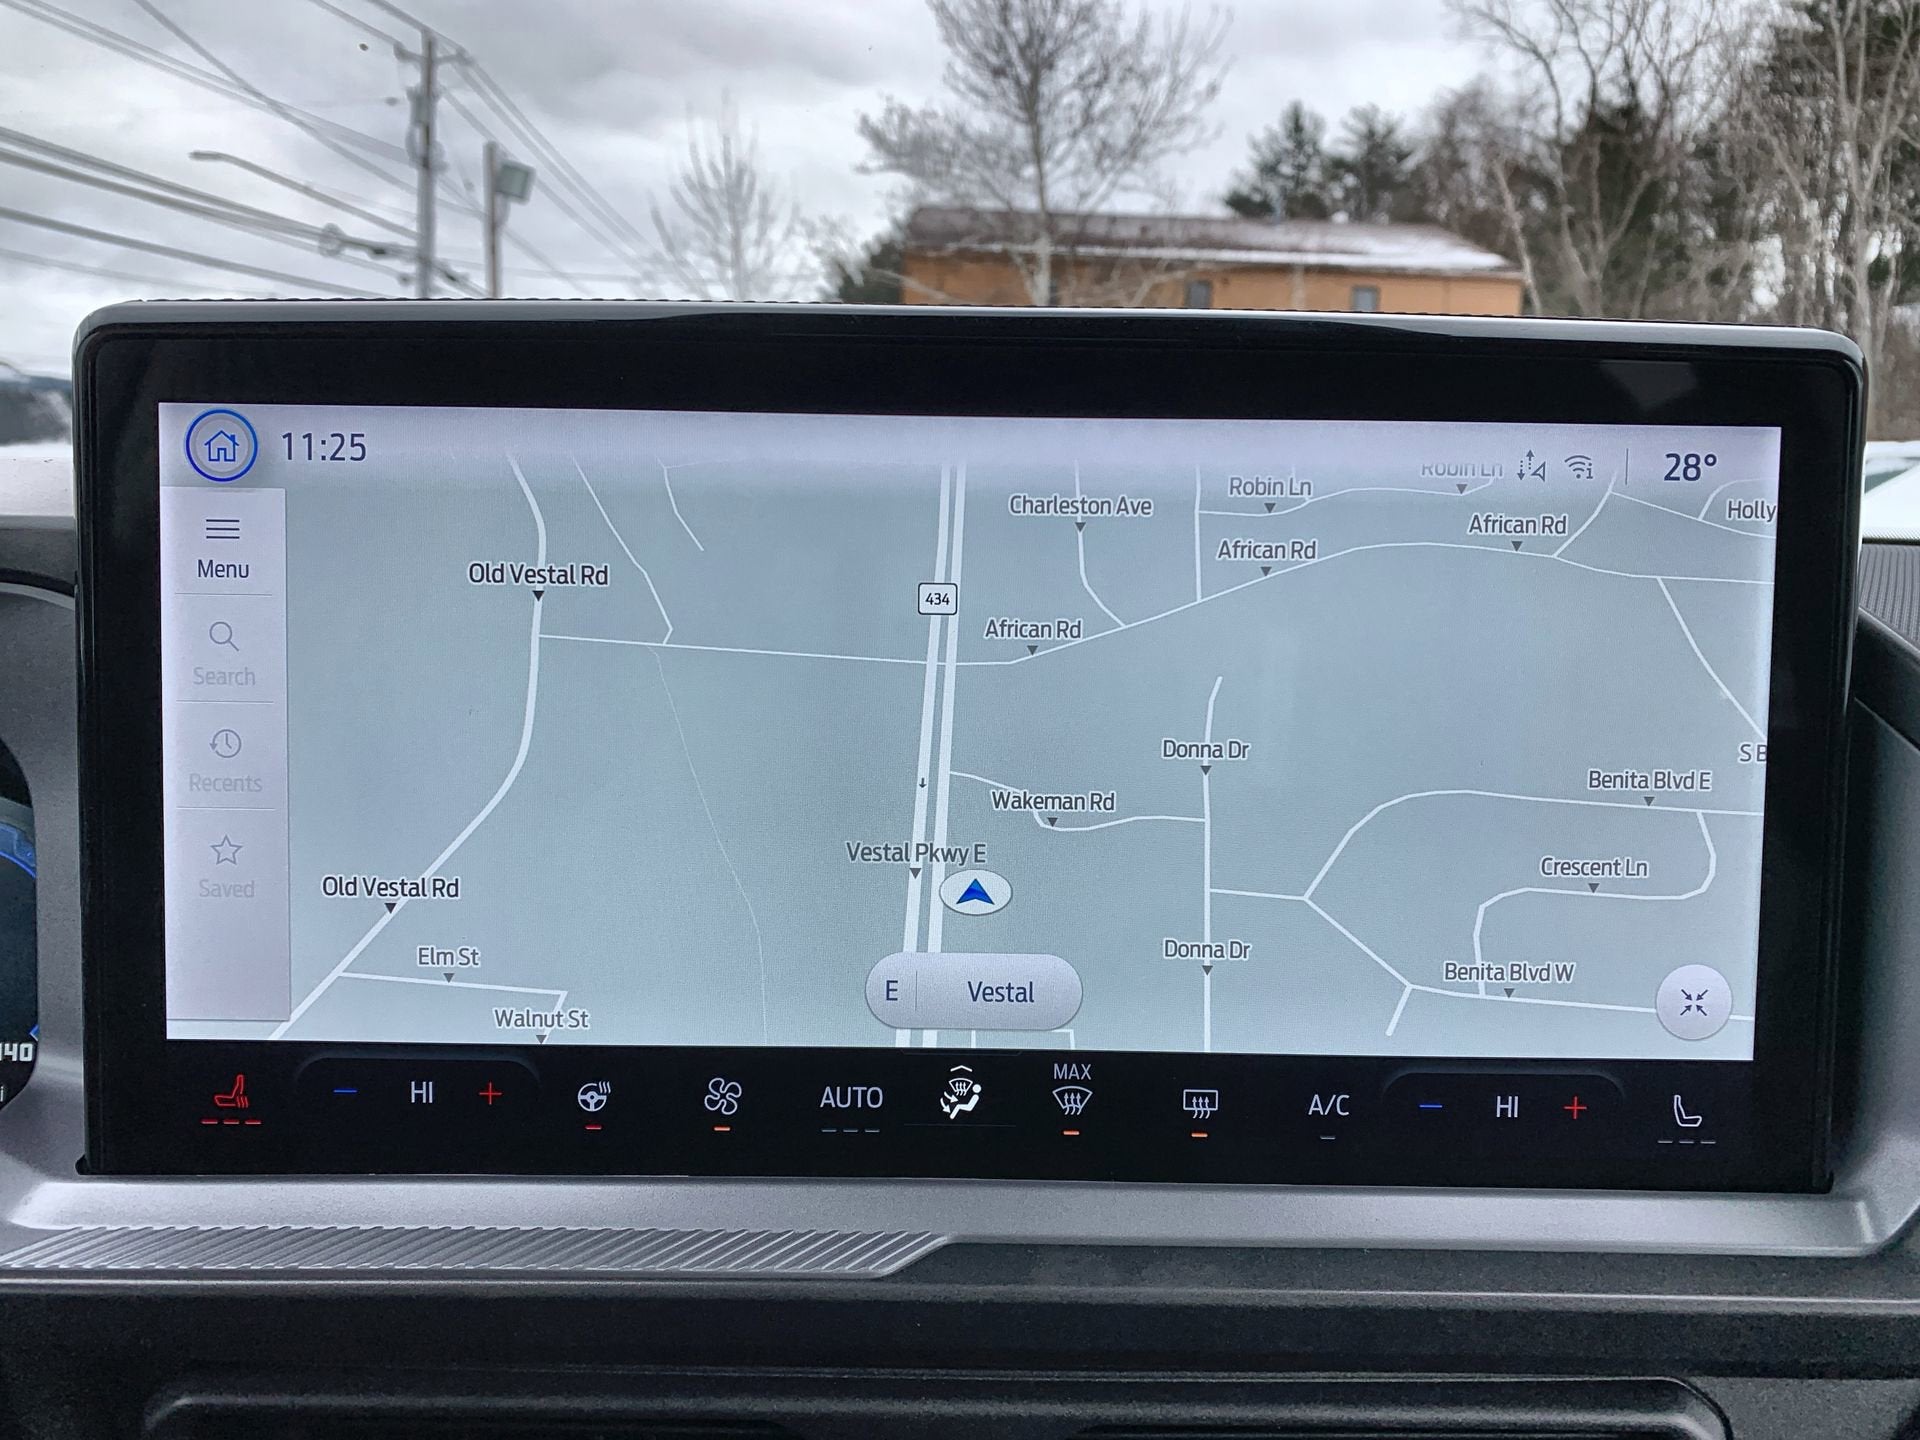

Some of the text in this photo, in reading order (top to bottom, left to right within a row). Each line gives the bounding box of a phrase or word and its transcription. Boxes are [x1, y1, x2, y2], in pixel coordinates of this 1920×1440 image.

[282, 432, 367, 462] 11:25
[1663, 453, 1717, 482] 28°
[1229, 477, 1311, 496] Robin Ln
[1010, 496, 1152, 515] Charleston Ave
[1728, 500, 1775, 520] Holly
[1468, 515, 1567, 534] African Rd
[1217, 541, 1316, 560] African Rd
[197, 559, 249, 579] Menu
[469, 563, 609, 586] Old Vestal Rd
[925, 592, 950, 606] 434
[985, 620, 1081, 639] African Rd
[193, 667, 256, 686] Search
[1163, 740, 1249, 759] Donna Dr
[1739, 744, 1751, 762] S
[189, 774, 263, 793] Recents
[1588, 770, 1711, 790] Benita Blvd E
[992, 791, 1115, 811] Wakeman Rd
[847, 842, 986, 866] Vestal Pkwy E
[1541, 858, 1648, 876] Crescent Ln
[200, 879, 255, 898] Saved
[322, 876, 459, 898] Old Vestal Rd
[418, 947, 480, 966] Elm St
[1164, 940, 1250, 959] Donna Dr
[1444, 962, 1575, 981] Benita Blvd W
[885, 981, 1034, 1003] E Vestal
[495, 1009, 588, 1029] Walnut St
[1054, 1063, 1091, 1080] MAX
[411, 1081, 432, 1103] HI
[820, 1086, 883, 1109] AUTO
[1309, 1094, 1350, 1116] A/C
[1497, 1096, 1518, 1118] HI
